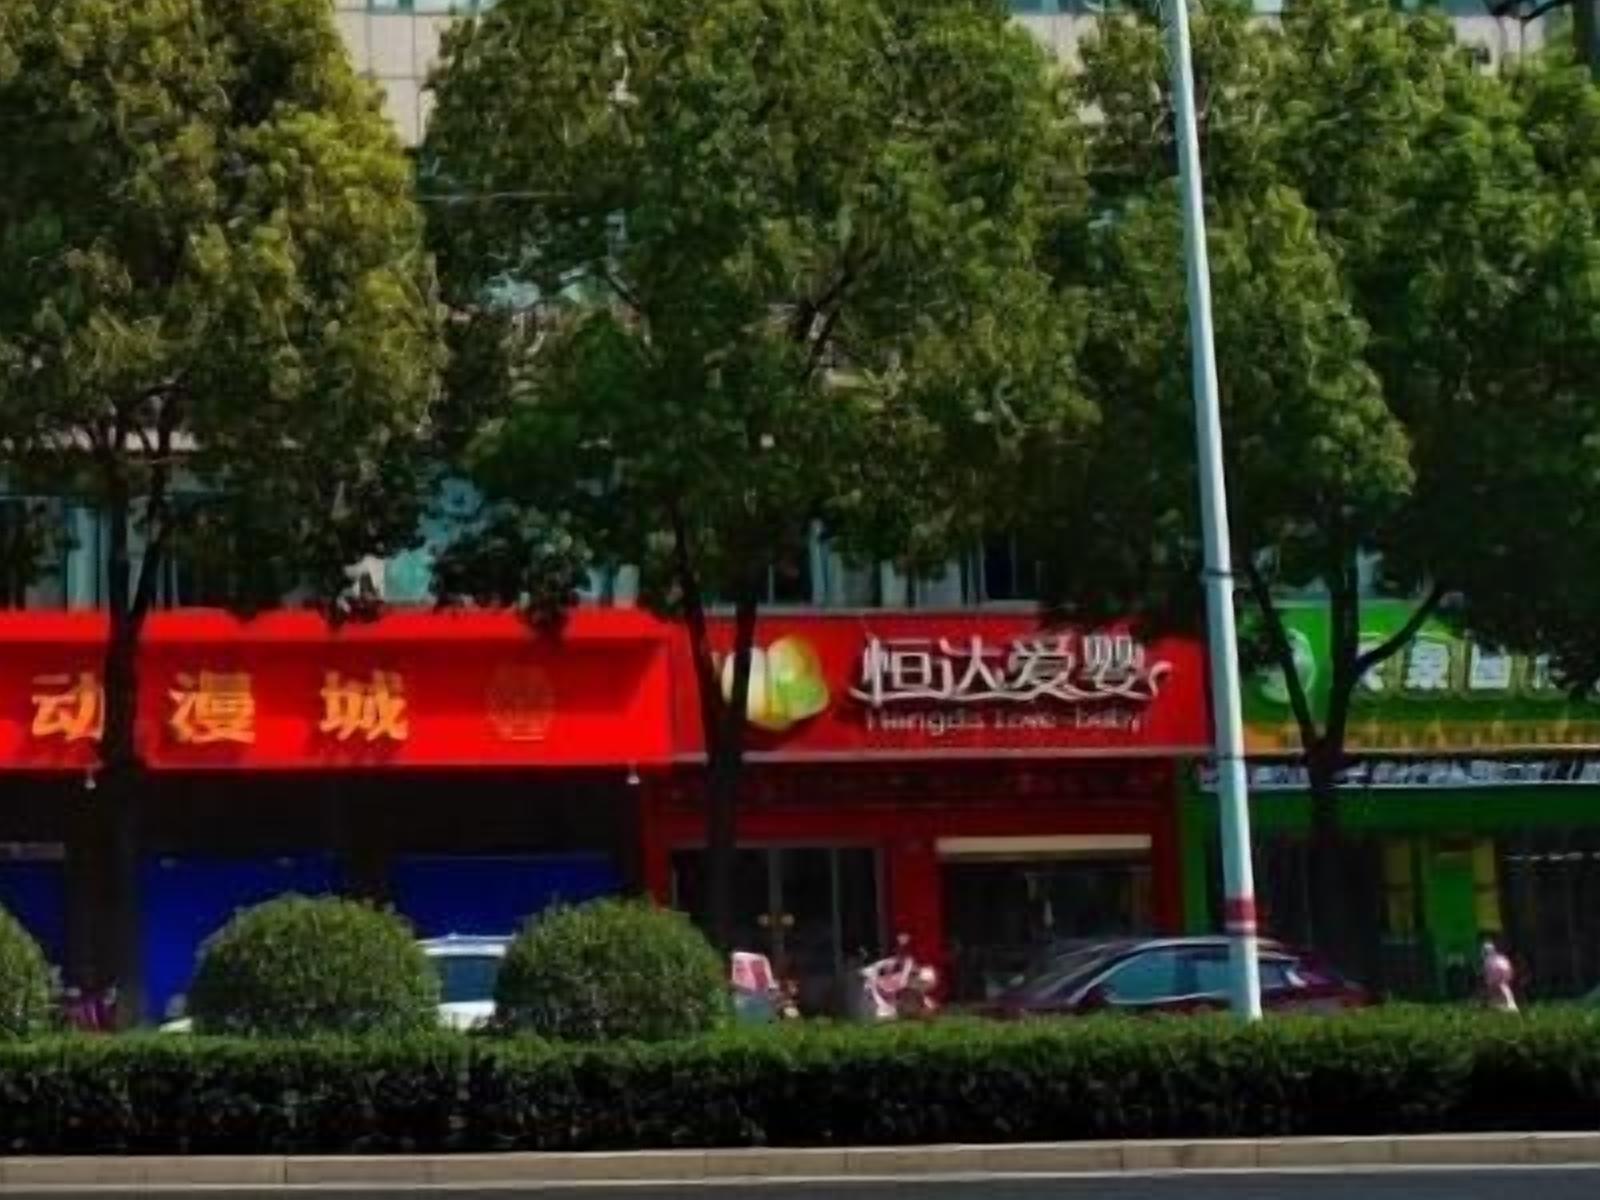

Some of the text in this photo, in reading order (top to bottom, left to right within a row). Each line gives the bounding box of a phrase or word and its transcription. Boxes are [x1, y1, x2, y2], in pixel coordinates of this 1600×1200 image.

[31, 668, 409, 743] 动漫城
[850, 634, 1172, 708] 恒达爱婴
